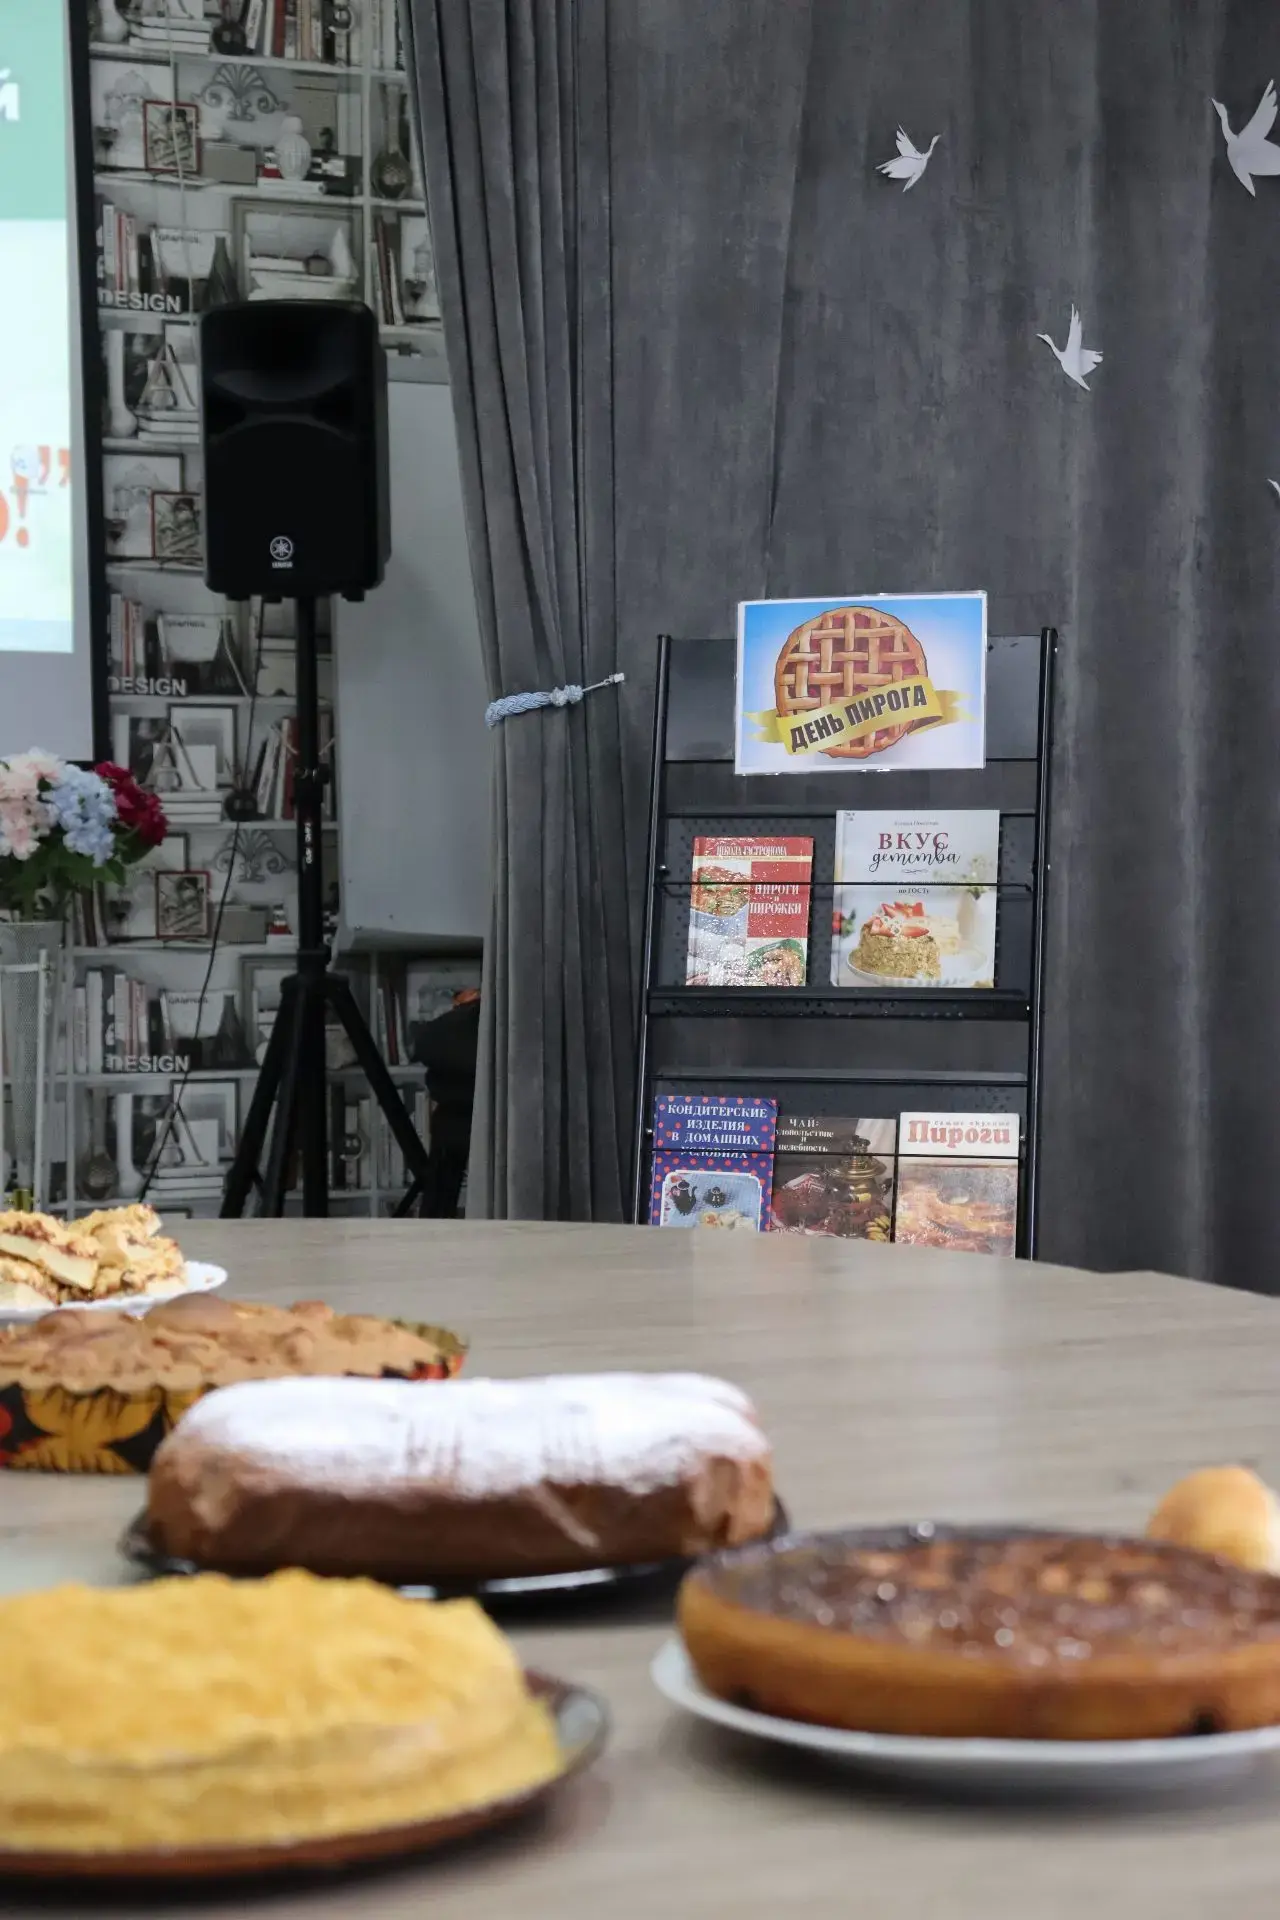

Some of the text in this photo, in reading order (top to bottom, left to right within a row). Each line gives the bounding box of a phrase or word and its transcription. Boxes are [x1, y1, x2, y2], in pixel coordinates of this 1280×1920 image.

[97, 286, 180, 313] DESIGN
[107, 676, 187, 696] DESIGN
[790, 685, 926, 752] ДЕНЬ ПИРОГА
[878, 832, 949, 850] ВКУС
[869, 842, 961, 872] детства
[750, 903, 802, 914] ПИРОЖКИ
[667, 1104, 768, 1118] КОНДИТЕРСКИЕ
[686, 1119, 745, 1132] ИЗДЕЛИЯ
[907, 1120, 1011, 1149] Пироги
[671, 1132, 760, 1146] В ДОМАШНИХ
